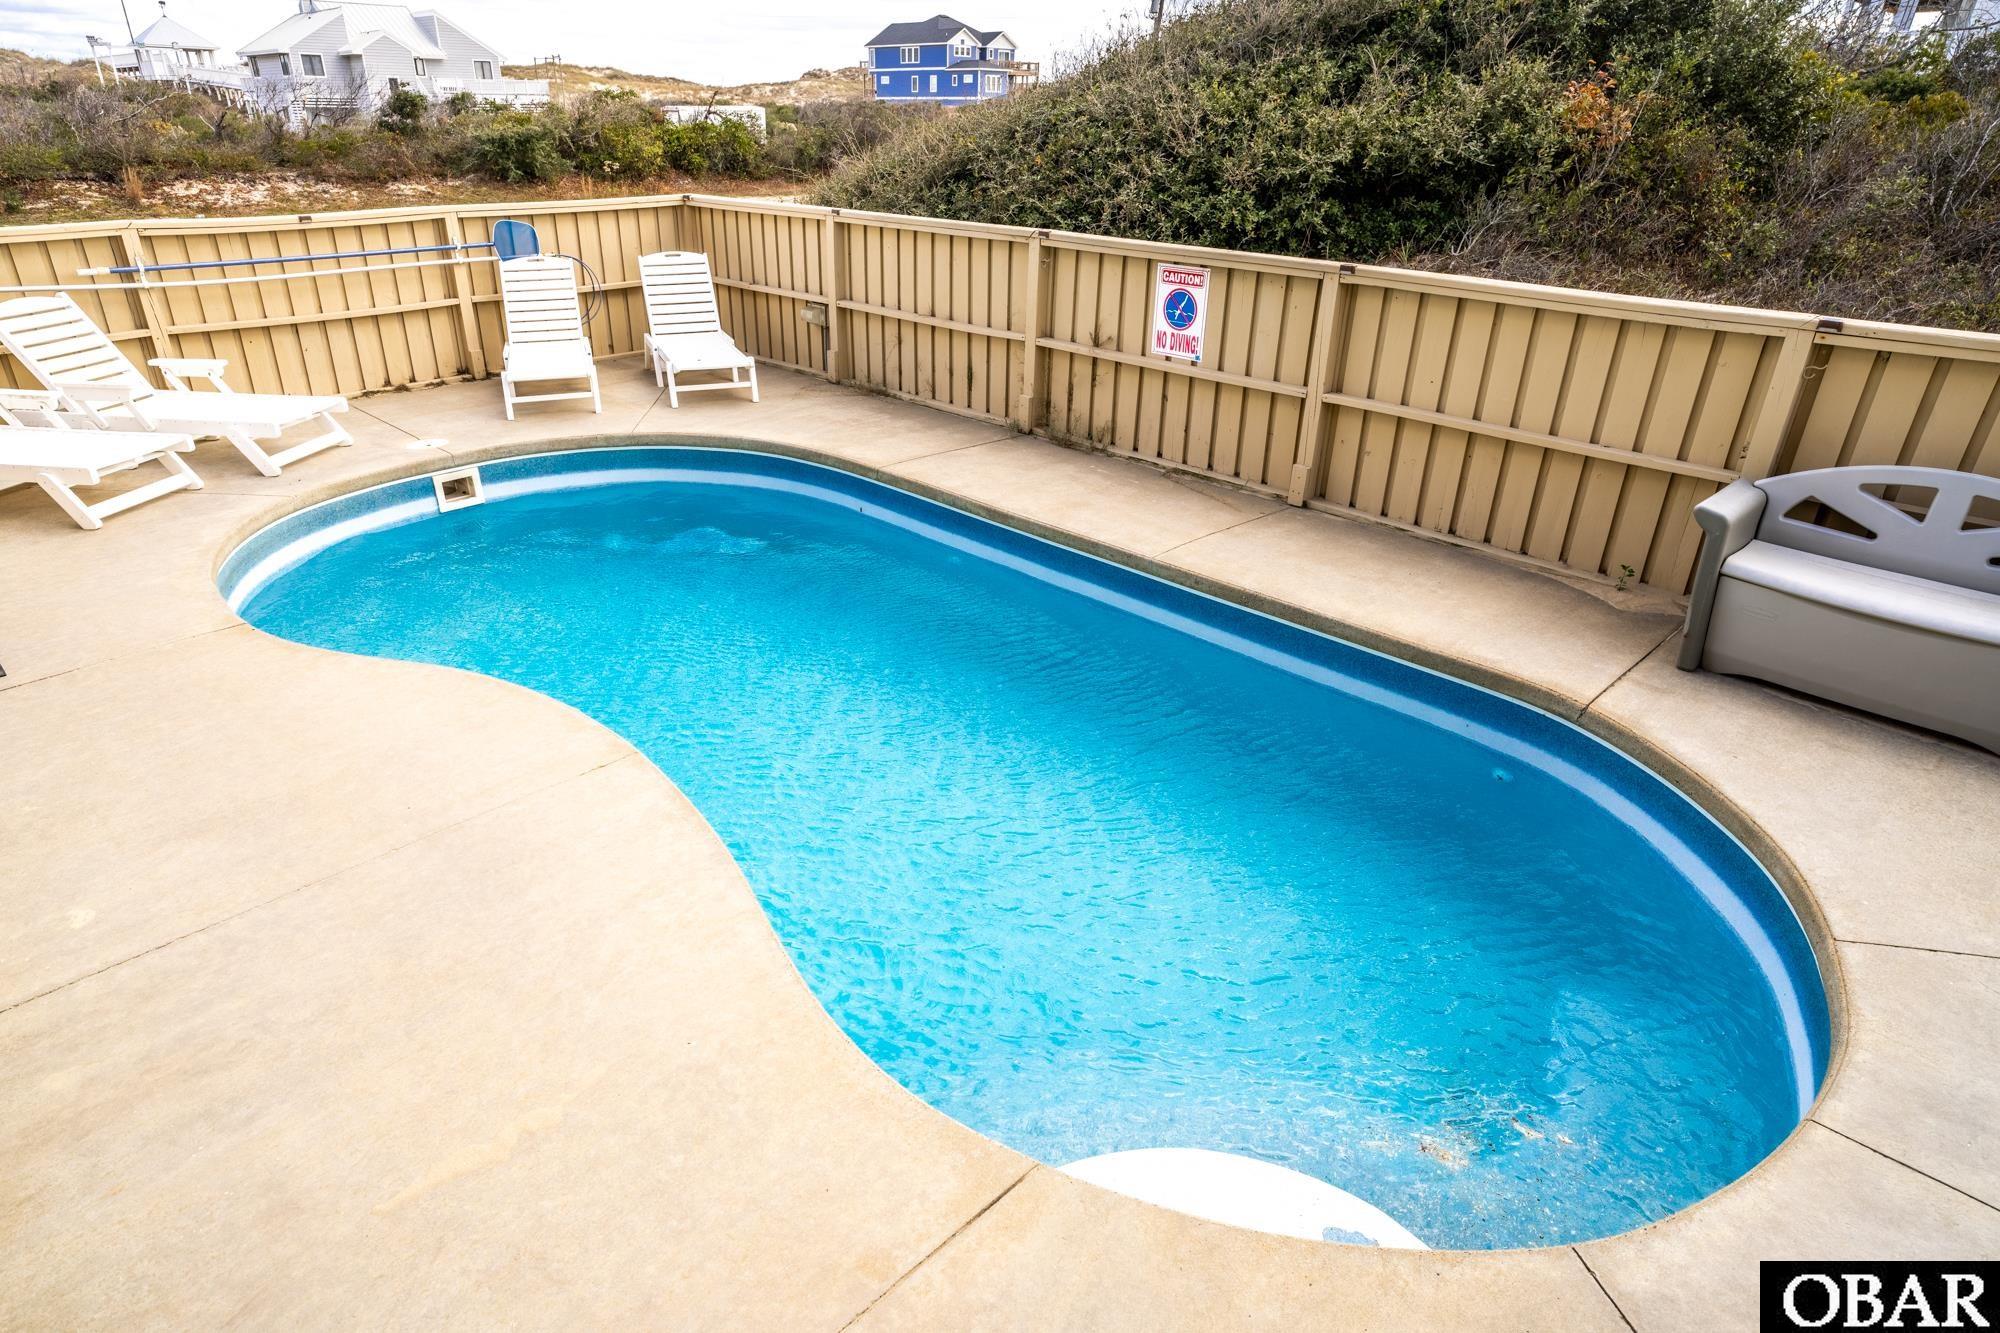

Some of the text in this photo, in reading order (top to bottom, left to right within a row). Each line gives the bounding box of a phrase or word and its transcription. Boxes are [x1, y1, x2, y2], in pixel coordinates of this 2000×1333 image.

[1163, 271, 1203, 285] CAUTION!
[1156, 330, 1199, 354] NO DIVING!
